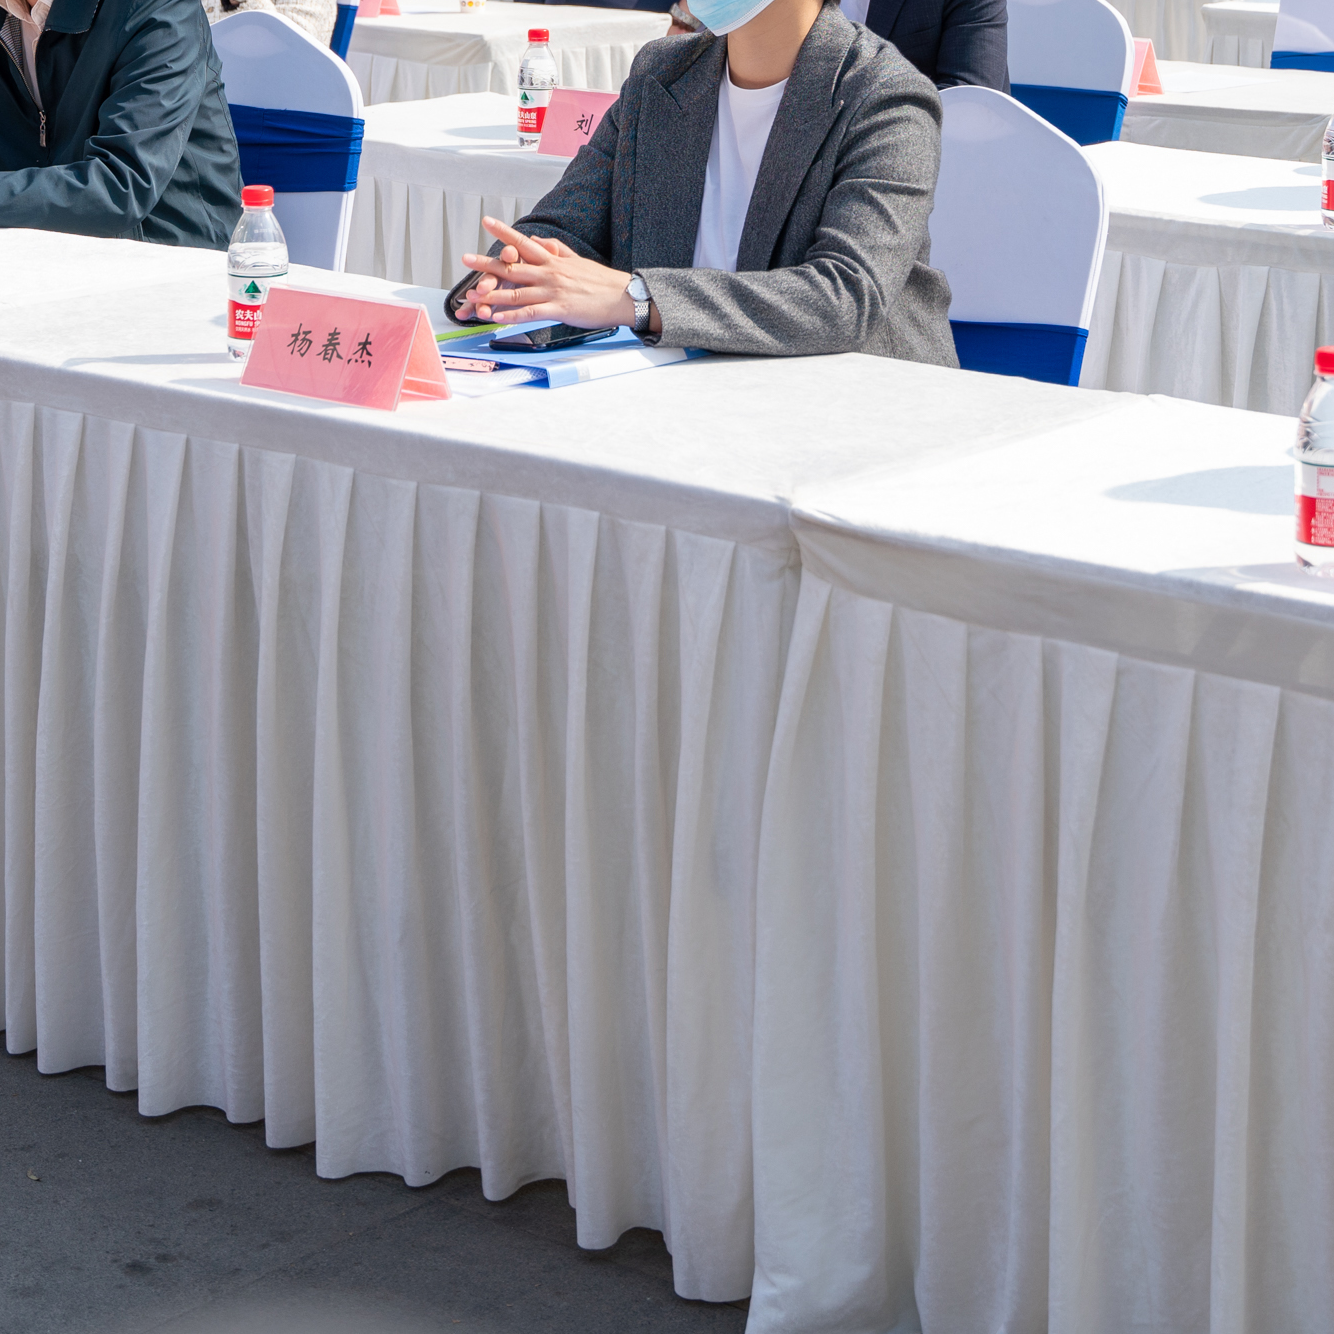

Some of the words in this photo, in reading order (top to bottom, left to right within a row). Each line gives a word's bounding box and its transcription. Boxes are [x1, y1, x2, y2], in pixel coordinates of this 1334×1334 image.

[574, 113, 594, 136] 刘
[287, 323, 373, 369] 杨春杰
